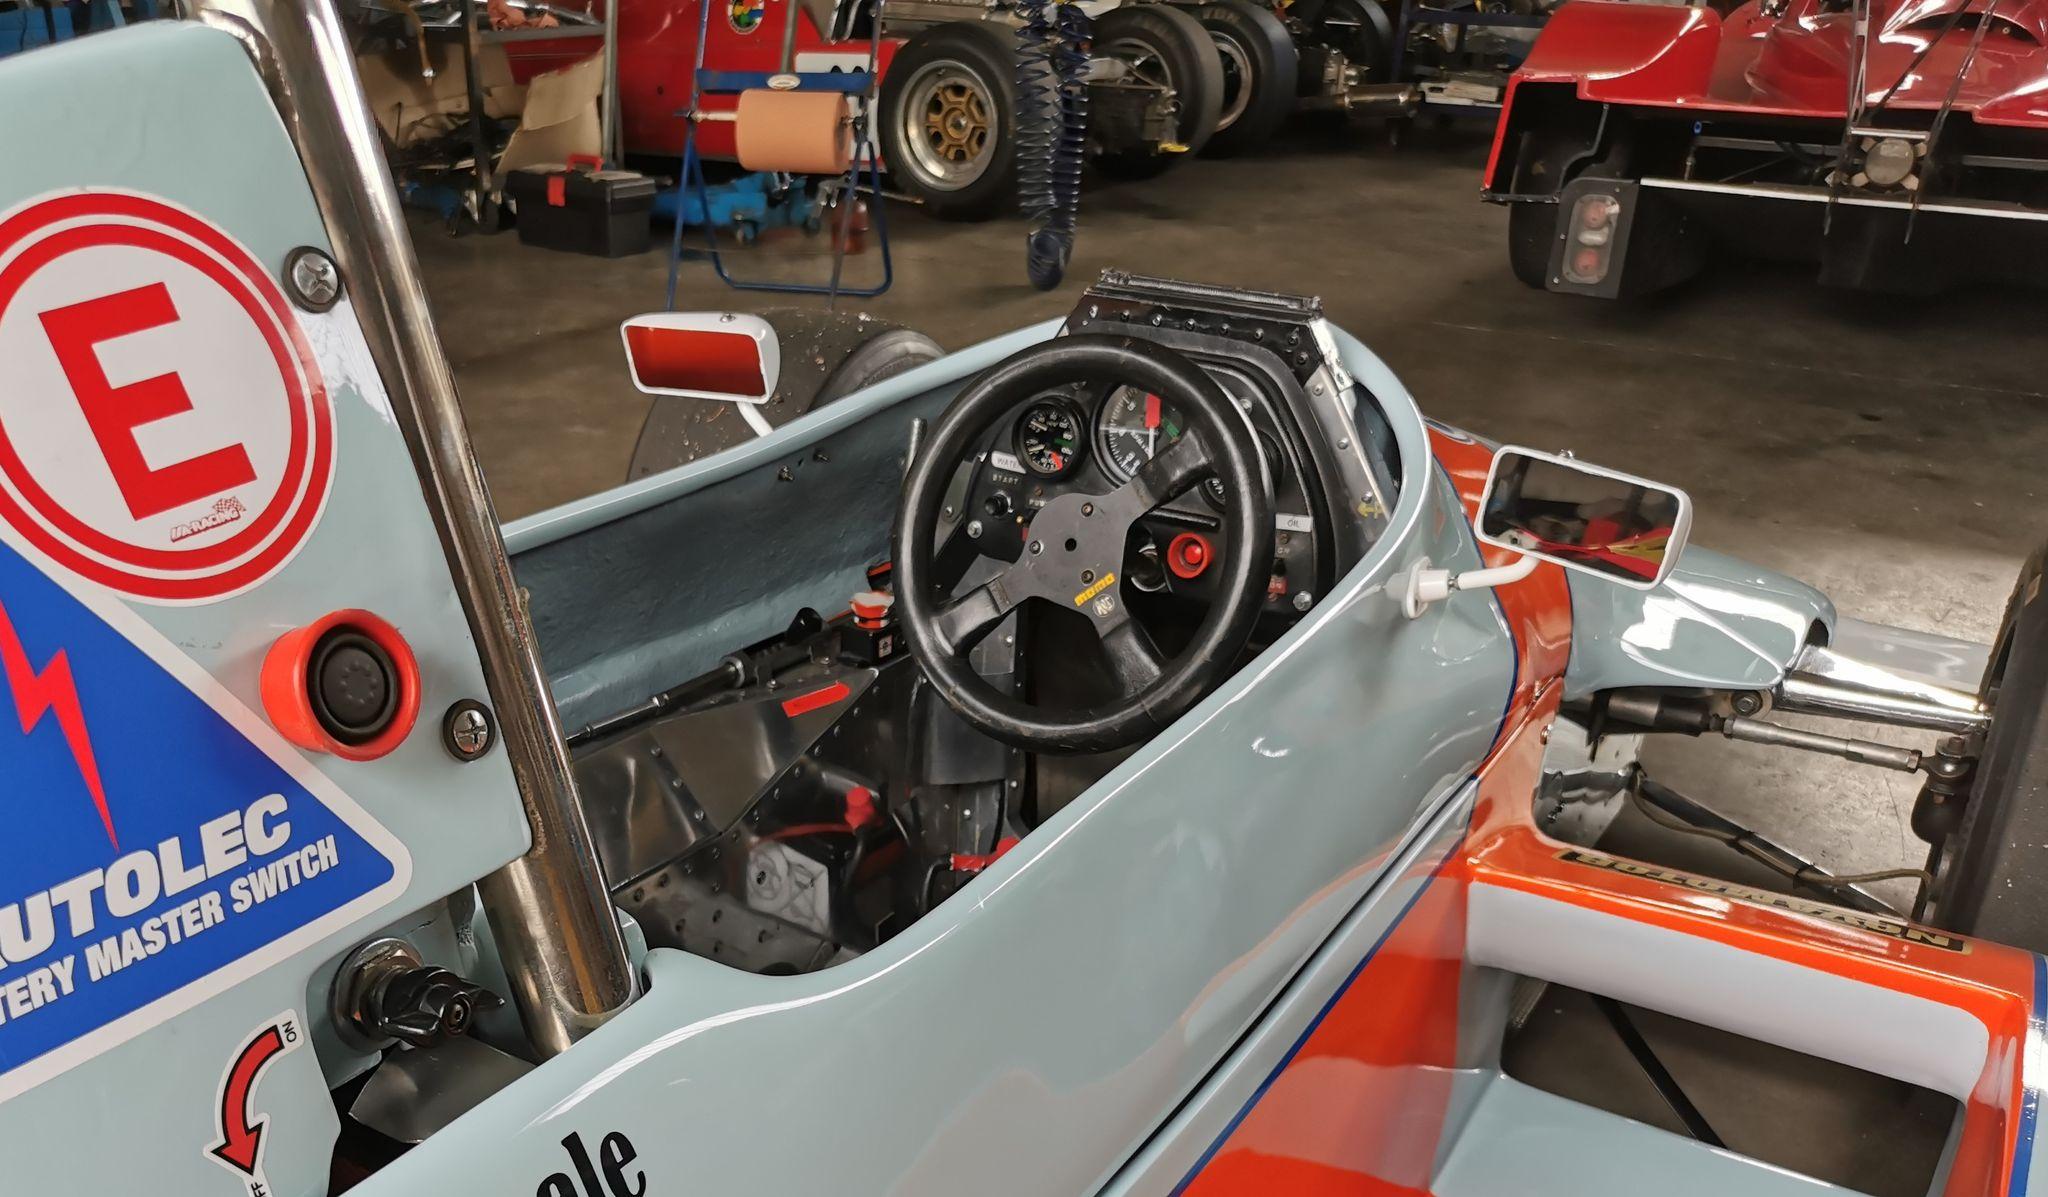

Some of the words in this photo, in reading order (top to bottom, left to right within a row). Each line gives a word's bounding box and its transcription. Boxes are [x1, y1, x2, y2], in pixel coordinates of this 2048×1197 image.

[38, 282, 257, 521] E
[992, 474, 1019, 485] START
[0, 793, 291, 970] UTOLEC
[84, 890, 226, 983] MASTER
[229, 834, 340, 914] SWITCH
[282, 1021, 297, 1043] ON
[251, 1182, 266, 1197] FF
